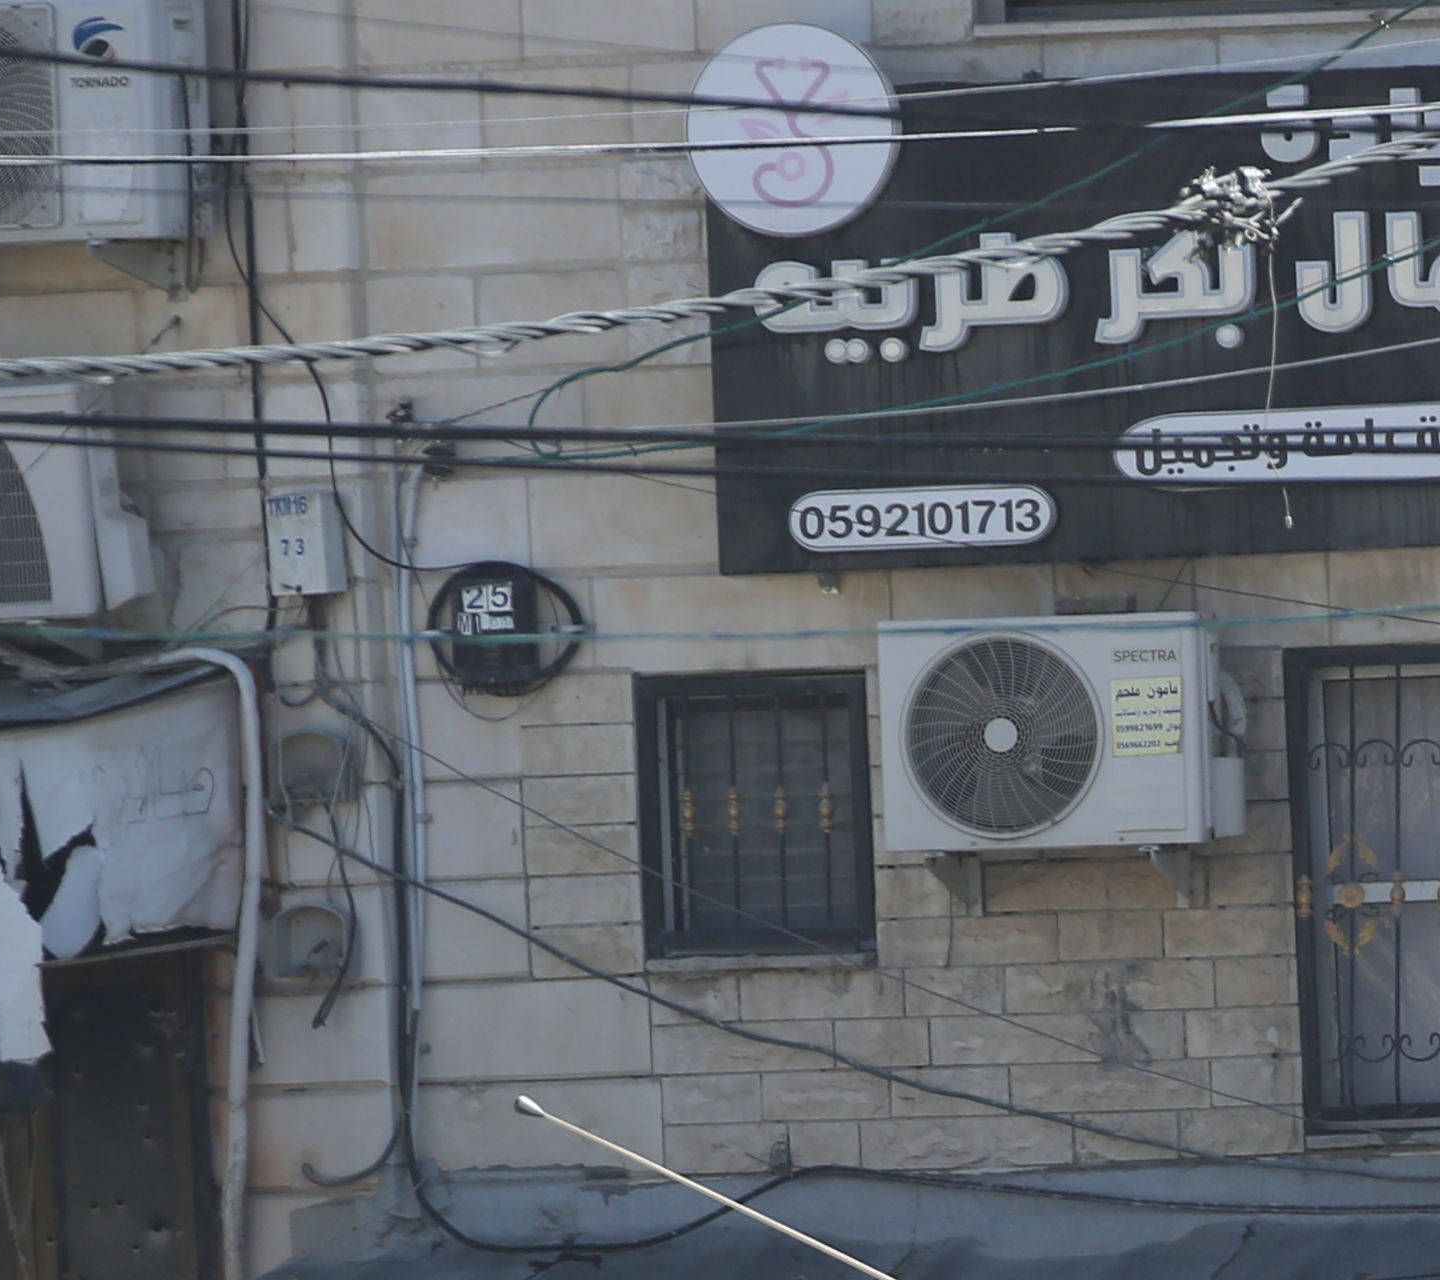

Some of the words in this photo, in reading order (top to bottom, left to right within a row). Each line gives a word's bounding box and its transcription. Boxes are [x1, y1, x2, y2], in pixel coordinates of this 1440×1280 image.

[69, 76, 130, 88] TORNADO
[1095, 232, 1258, 350] بكر
[1136, 423, 1288, 477] وتجميل
[1302, 417, 1398, 458] عامة
[797, 497, 1042, 541] 0592101713
[464, 586, 509, 610] 25
[1113, 648, 1177, 662] SPECTRA
